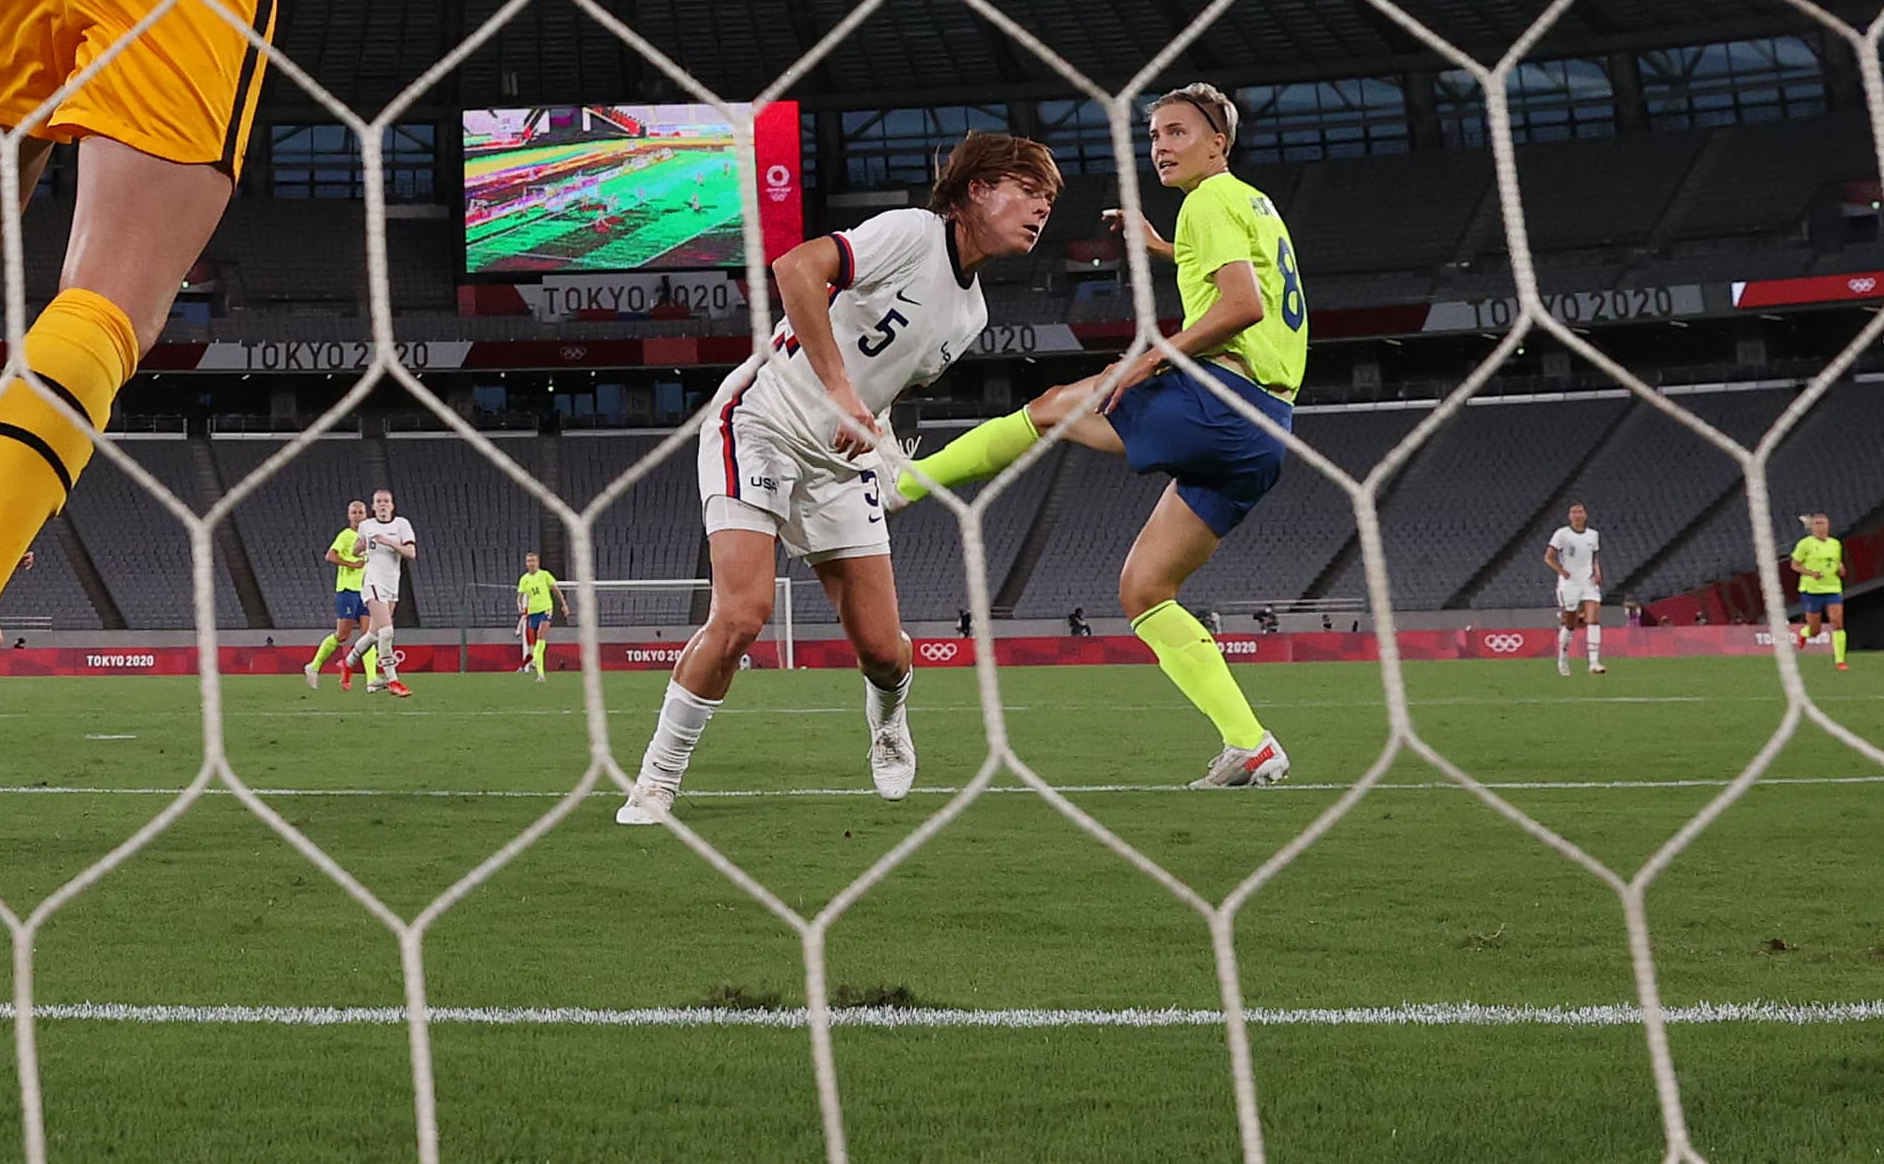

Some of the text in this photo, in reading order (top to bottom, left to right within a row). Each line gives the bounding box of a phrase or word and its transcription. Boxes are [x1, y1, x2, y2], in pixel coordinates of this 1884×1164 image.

[1277, 237, 1304, 332] 8
[543, 285, 644, 315] TOKYO
[1468, 285, 1671, 329] TOYO 2020
[858, 308, 909, 358] 5
[241, 341, 429, 371] TOKYO 220
[86, 655, 155, 667] TOKYO 2020
[626, 650, 666, 662] TOKYO
[1226, 641, 1257, 654] 2020
